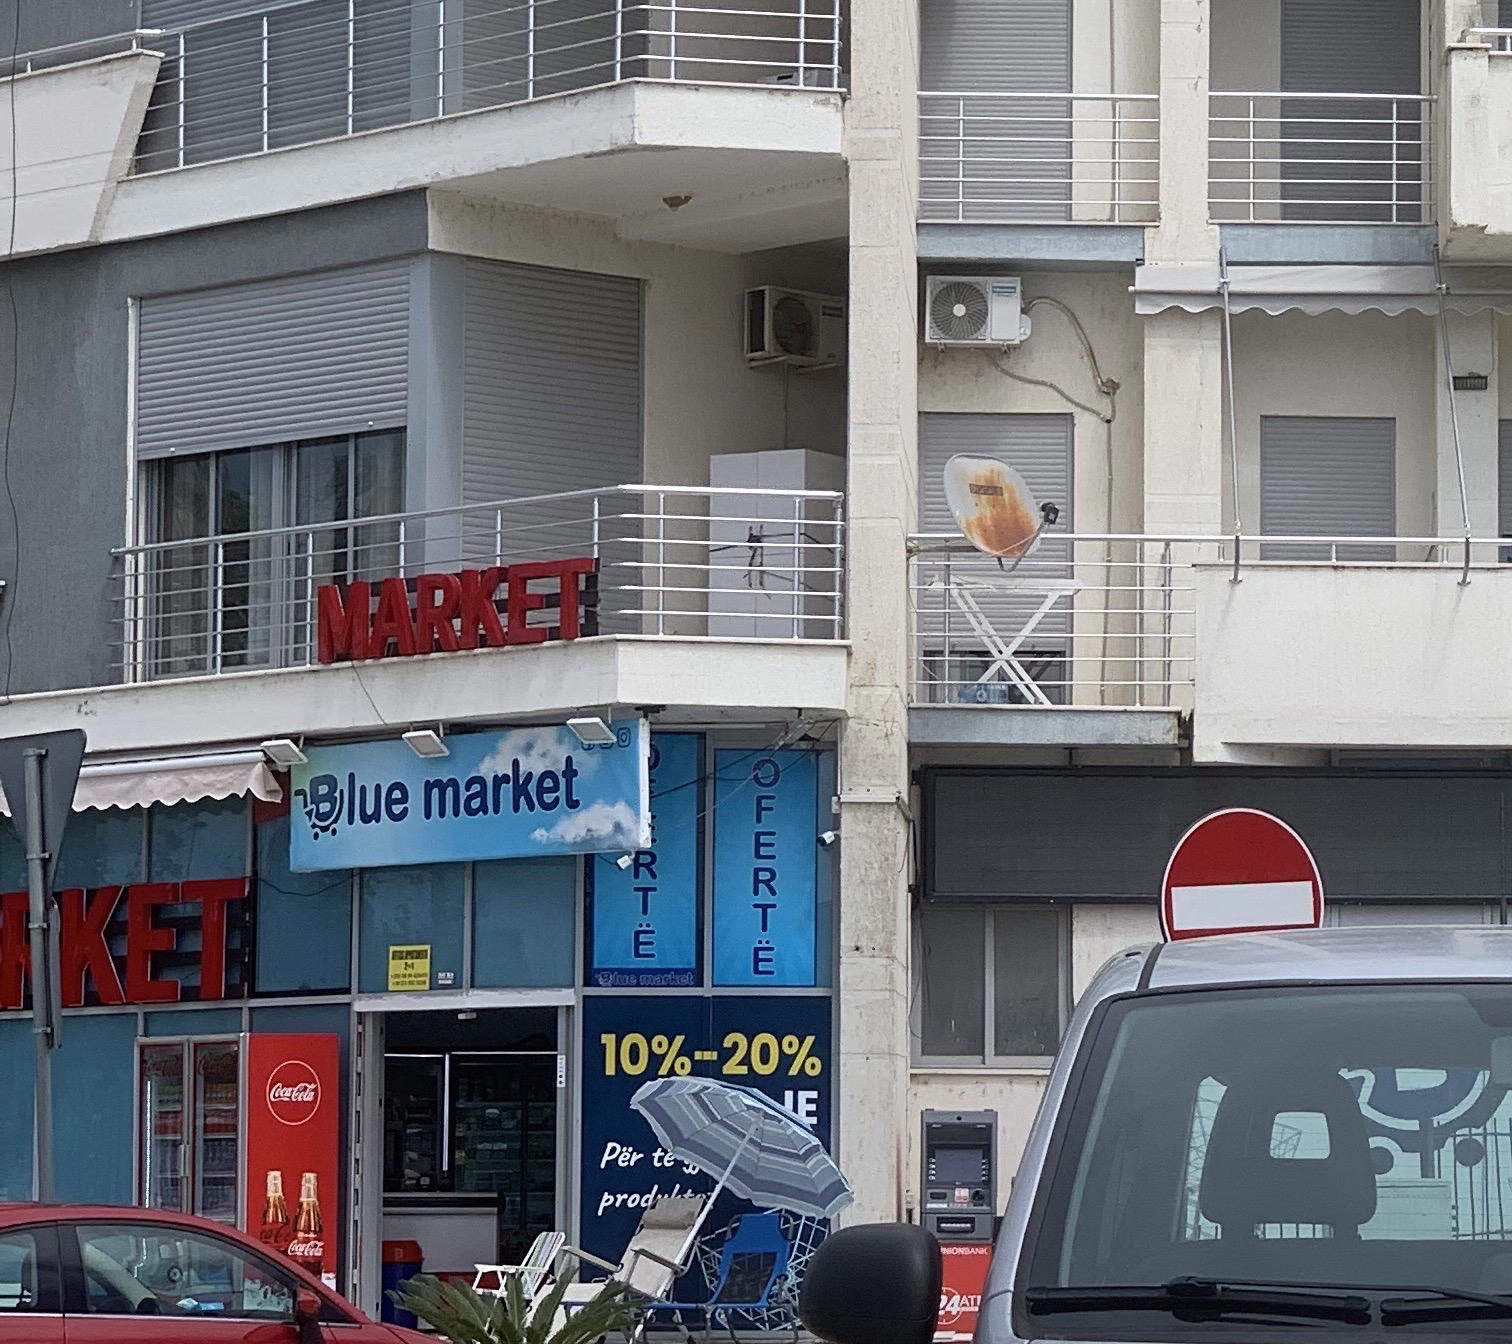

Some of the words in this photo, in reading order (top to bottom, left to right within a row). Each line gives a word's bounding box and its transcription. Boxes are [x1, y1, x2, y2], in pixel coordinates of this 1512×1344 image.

[317, 558, 595, 665] MARKET
[306, 771, 410, 826] Blue
[423, 754, 581, 821] market
[752, 758, 781, 976] OFERTË
[639, 971, 695, 986] market
[600, 1032, 823, 1077] 10%-20%
[600, 1142, 644, 1169] Për
